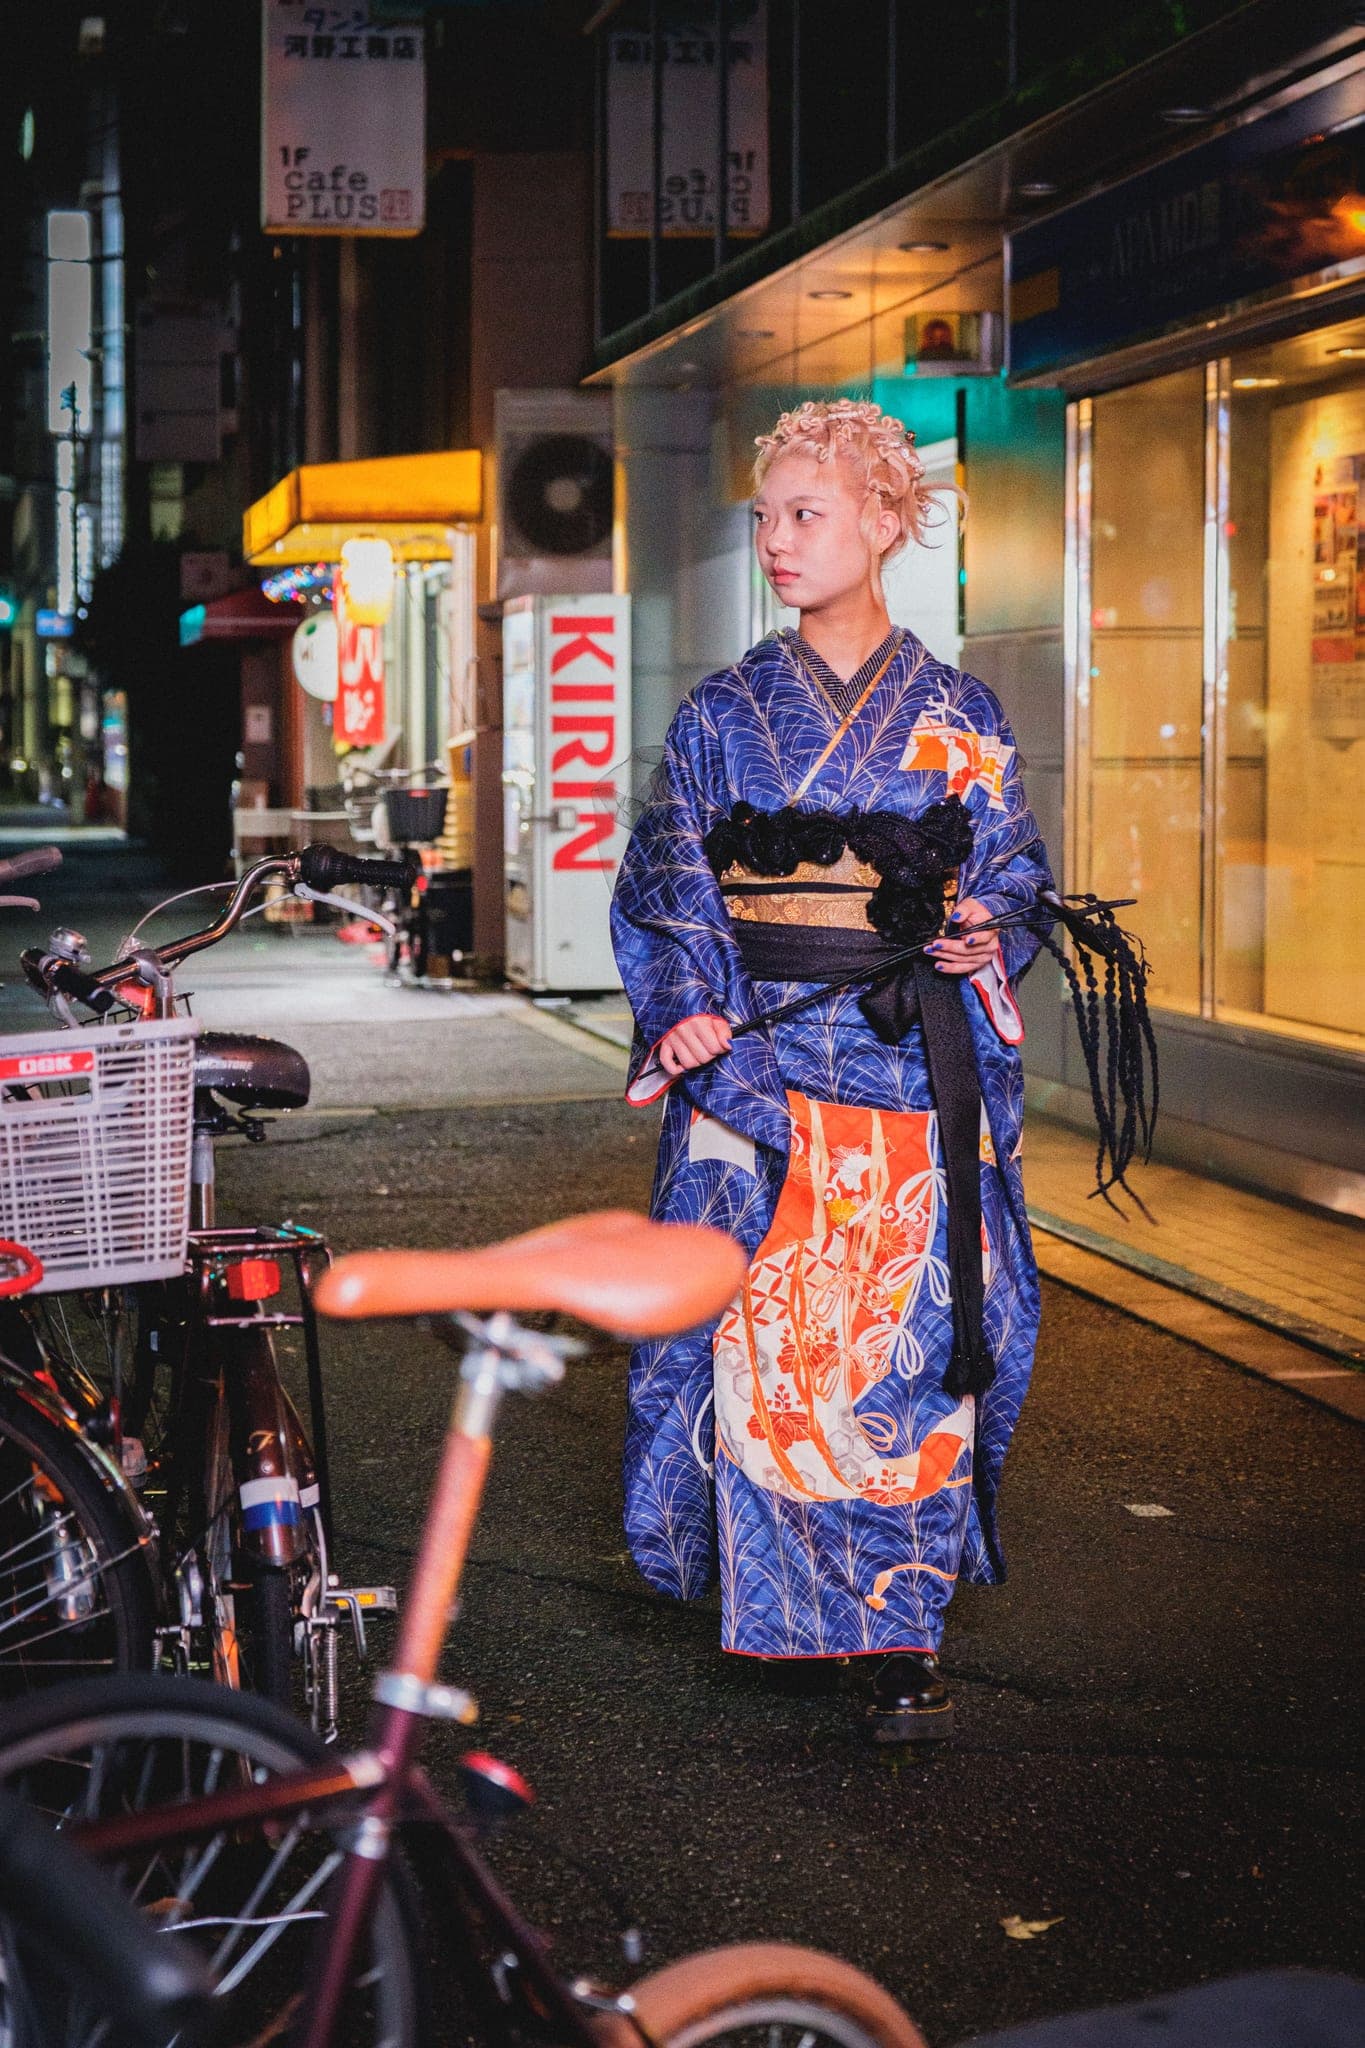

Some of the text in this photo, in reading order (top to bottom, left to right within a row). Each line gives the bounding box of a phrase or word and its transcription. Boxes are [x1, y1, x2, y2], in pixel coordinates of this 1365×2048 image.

[280, 146, 309, 166] 1F
[284, 165, 368, 191] cafe
[286, 194, 378, 219] PLUS
[551, 616, 615, 872] KIRIN
